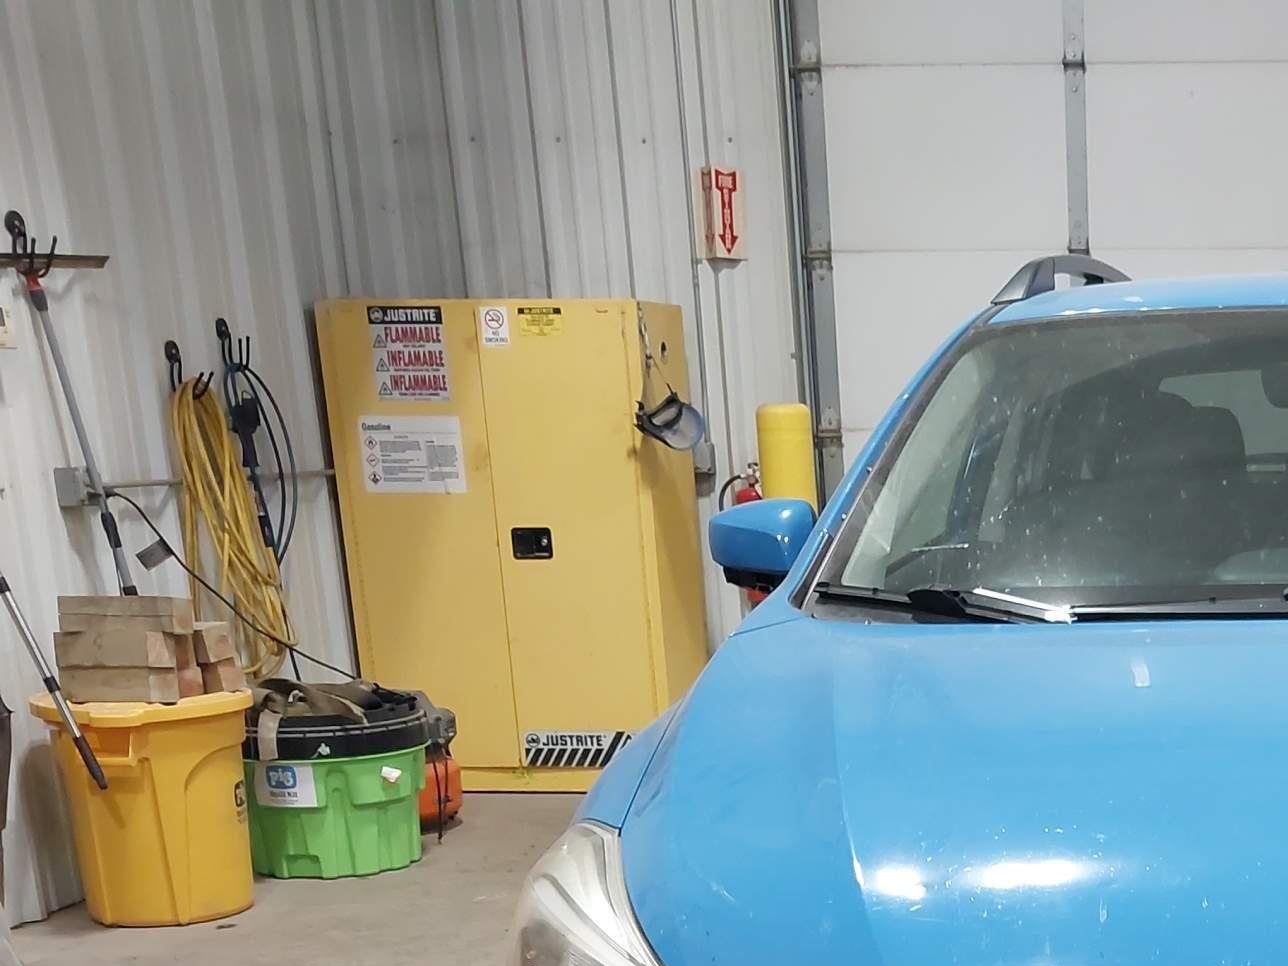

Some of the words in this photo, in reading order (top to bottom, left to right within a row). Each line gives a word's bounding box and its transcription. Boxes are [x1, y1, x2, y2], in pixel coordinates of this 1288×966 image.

[384, 308, 437, 322] JUSTRITE
[384, 326, 442, 344] FLAMMABLE
[386, 349, 445, 368] INFLAMABLE
[389, 374, 448, 392] INFLAMMABLE
[542, 734, 603, 747] JUSTRITE
